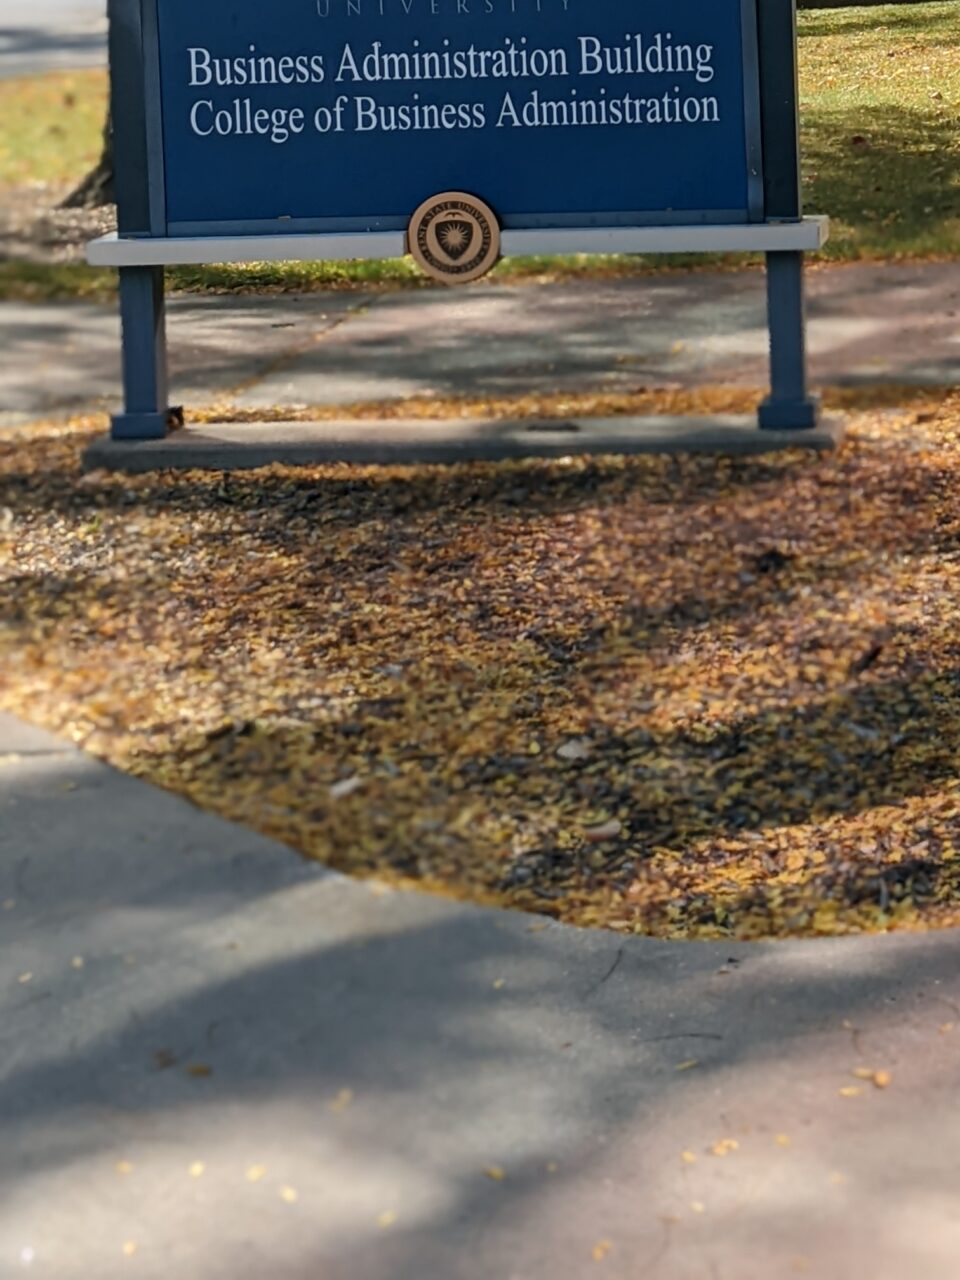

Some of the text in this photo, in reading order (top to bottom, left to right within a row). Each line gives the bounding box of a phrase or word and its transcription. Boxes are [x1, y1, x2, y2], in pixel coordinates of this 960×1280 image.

[187, 32, 715, 87] Business Administration Building
[190, 86, 721, 144] College of Business Administration
